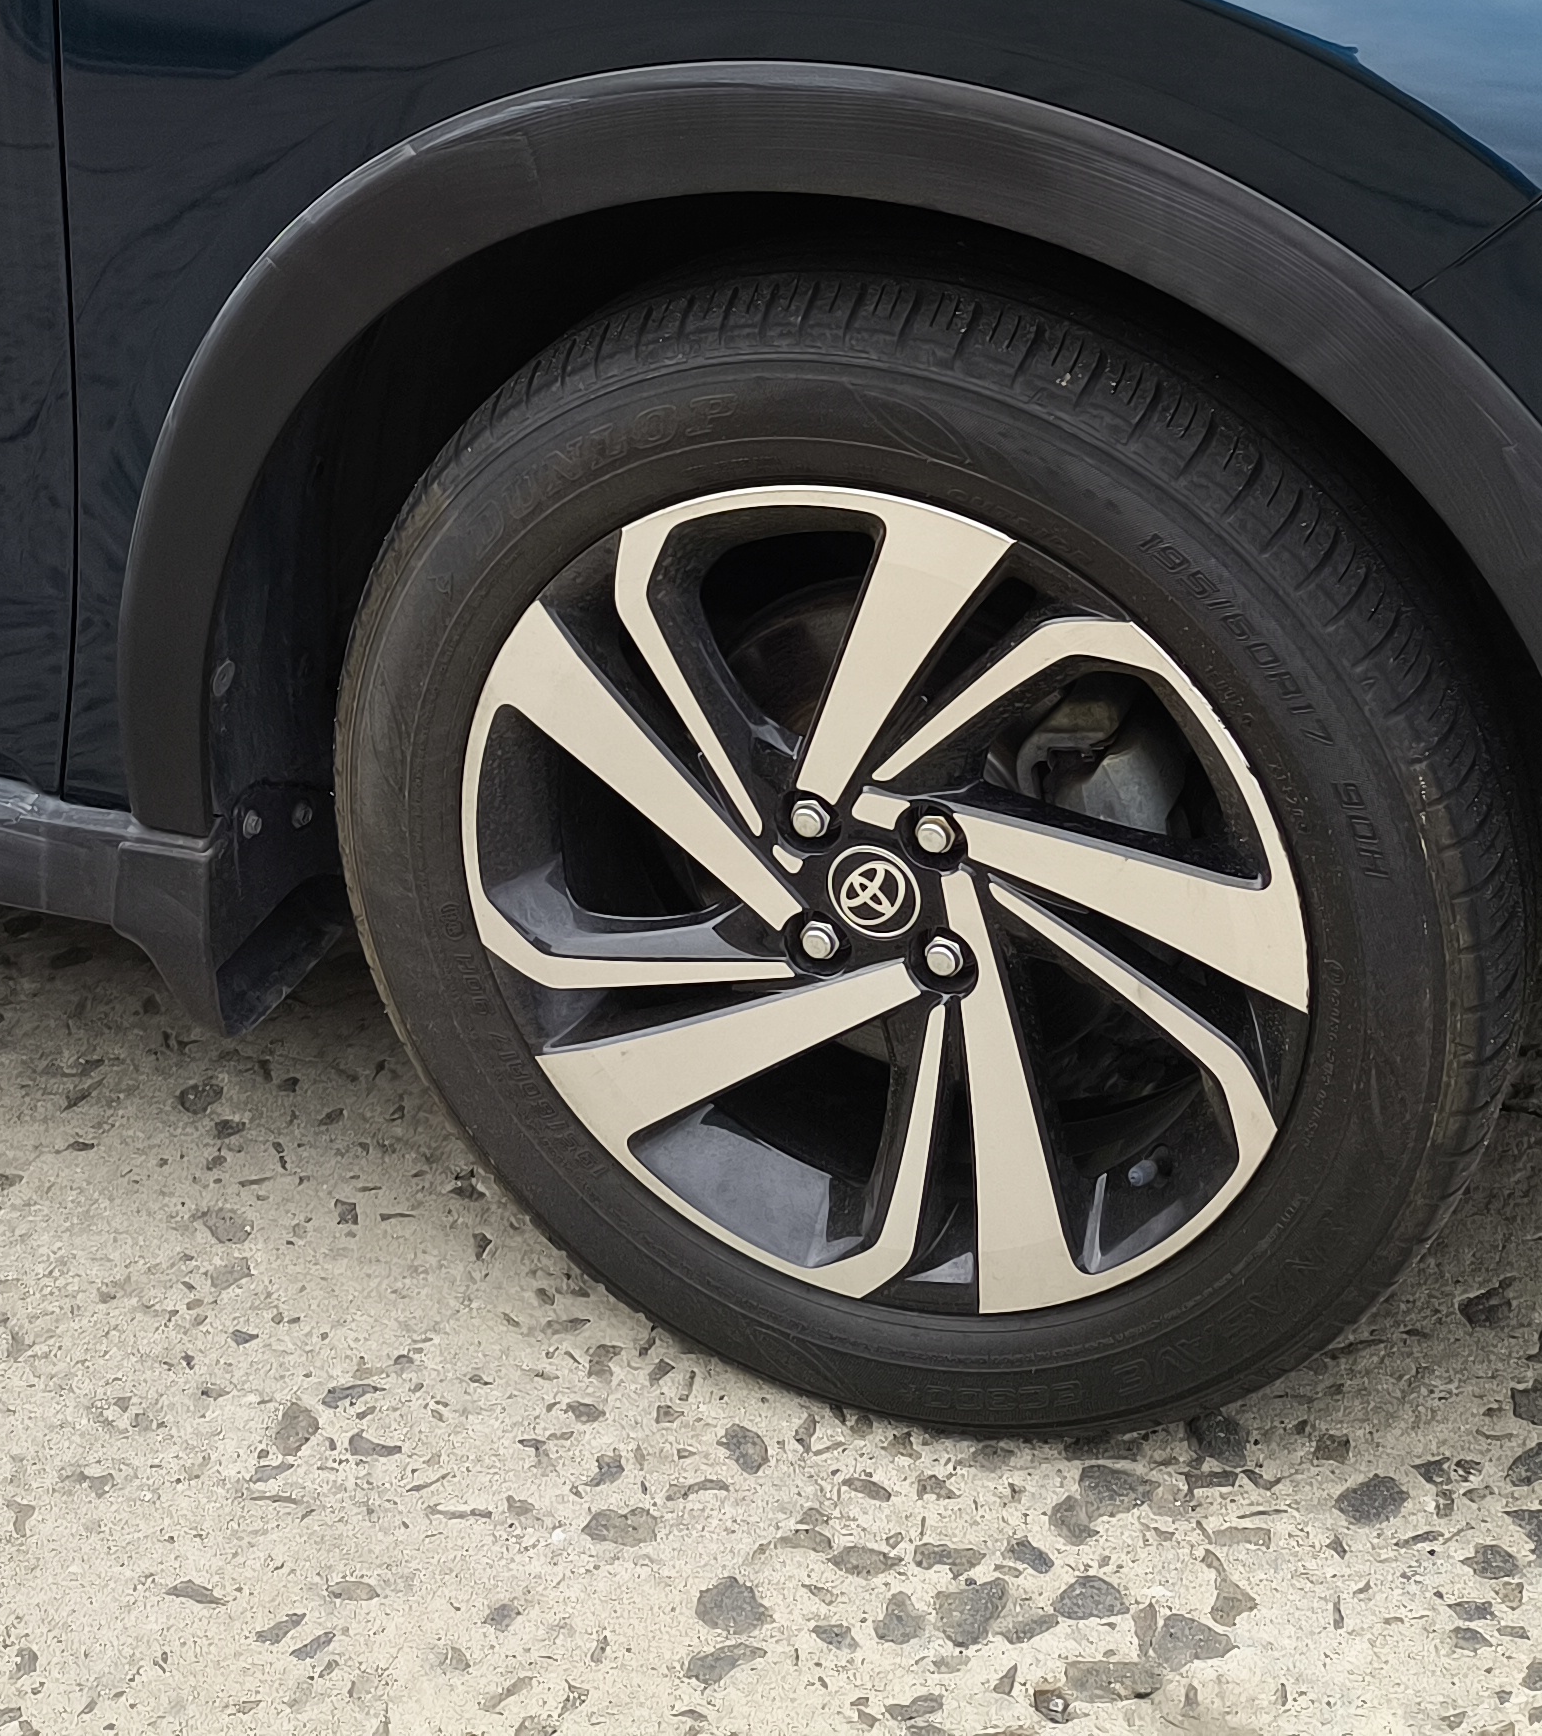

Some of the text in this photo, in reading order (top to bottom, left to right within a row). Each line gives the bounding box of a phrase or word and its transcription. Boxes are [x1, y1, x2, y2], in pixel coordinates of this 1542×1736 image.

[465, 392, 739, 561] DUNLOP
[1137, 530, 1336, 748] 195/60R17
[1332, 779, 1393, 881] 90H
